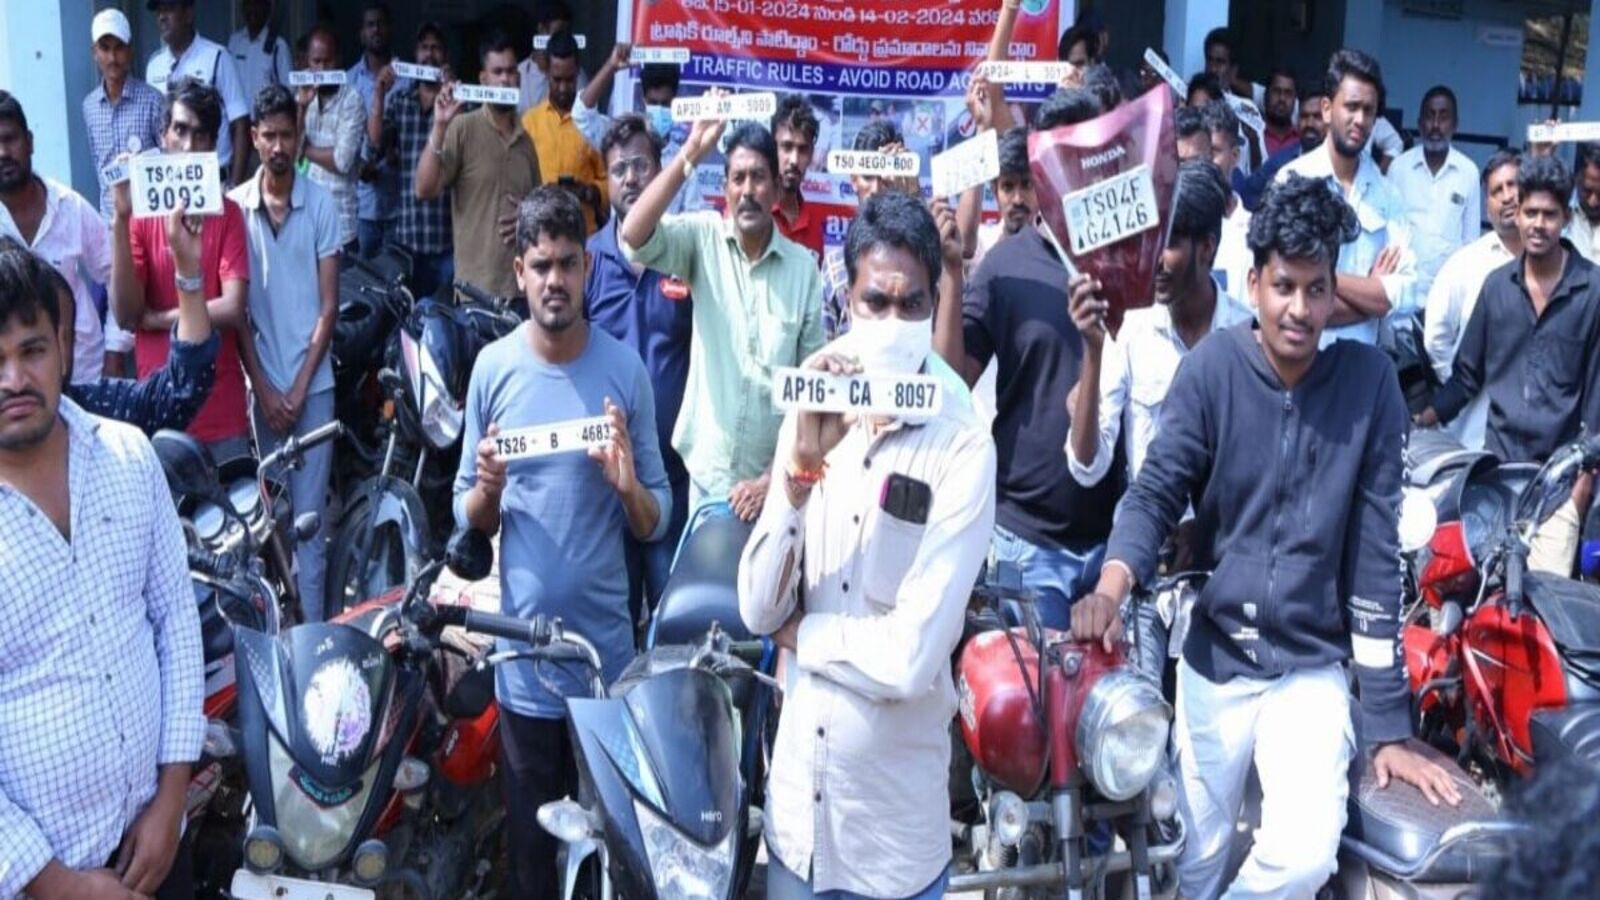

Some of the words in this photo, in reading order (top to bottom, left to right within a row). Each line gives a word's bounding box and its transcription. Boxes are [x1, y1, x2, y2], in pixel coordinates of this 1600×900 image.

[860, 8, 965, 26] 14-02-2024
[692, 56, 763, 80] TRAFFIC
[767, 62, 824, 84] RULES
[838, 68, 890, 89] AVOID
[895, 71, 945, 91] ROAD
[1081, 144, 1126, 170] HONDA
[849, 379, 872, 406] CA
[550, 432, 559, 449] B
